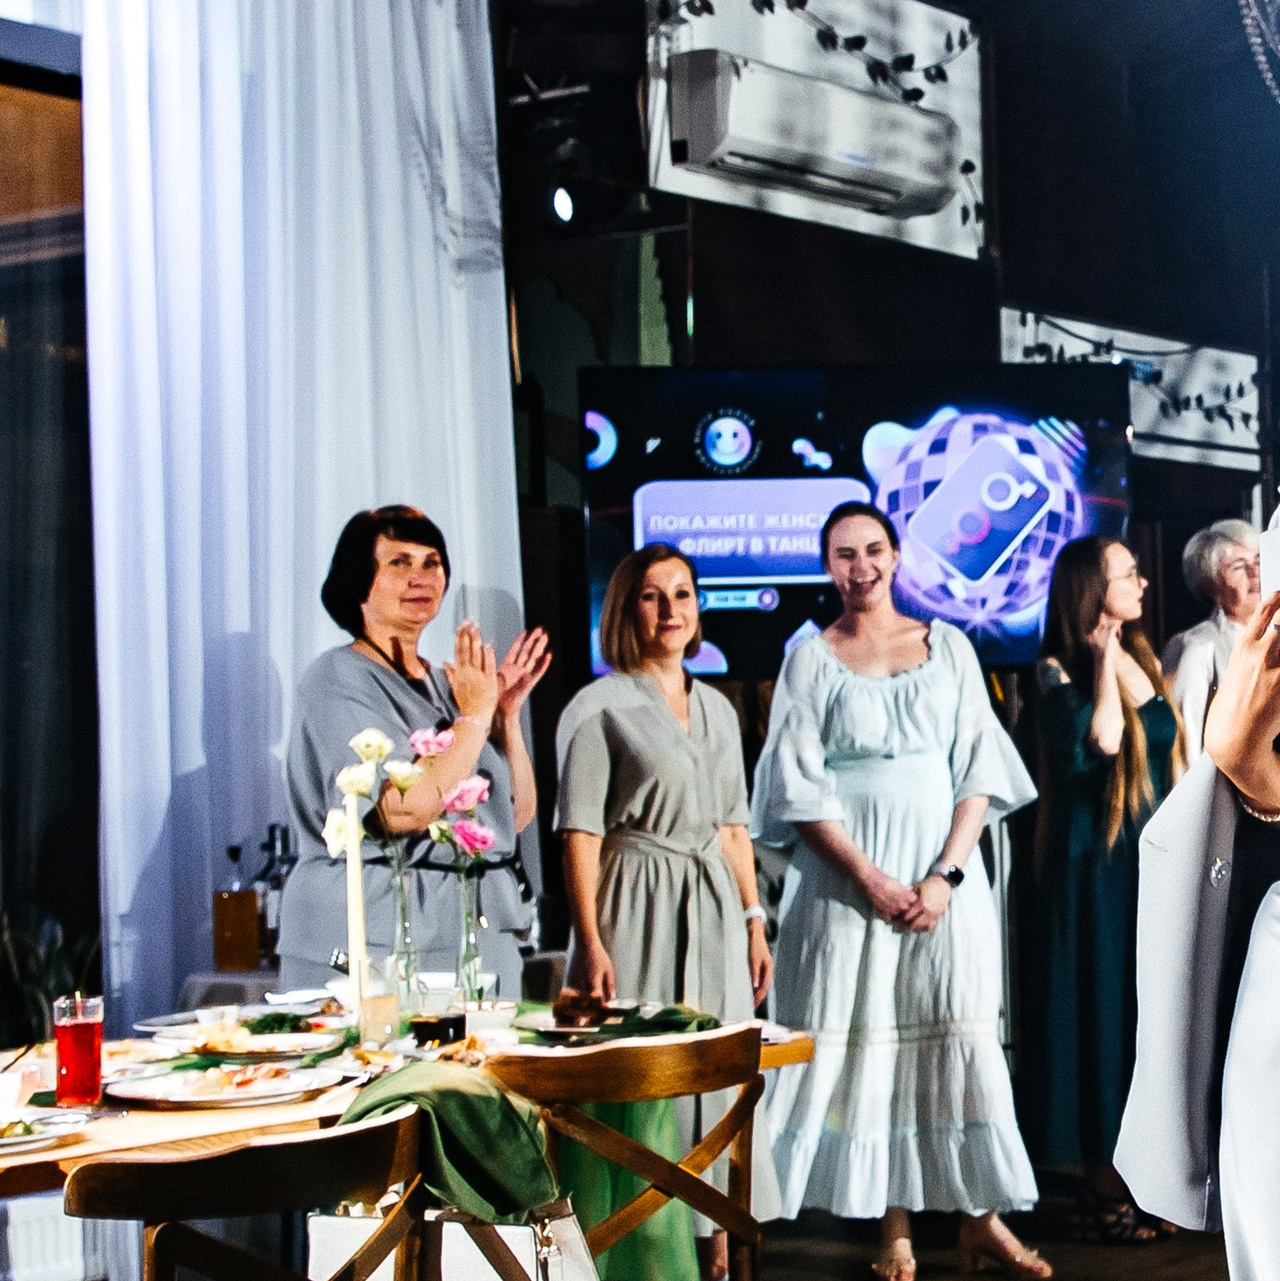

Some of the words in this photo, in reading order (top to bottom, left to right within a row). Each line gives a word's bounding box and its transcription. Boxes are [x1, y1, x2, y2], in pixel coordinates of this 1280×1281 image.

[650, 514, 758, 530] ПОКАЖИТЕ
[680, 537, 746, 554] ФЛИРТ
[768, 536, 819, 555] ТАНЦ
